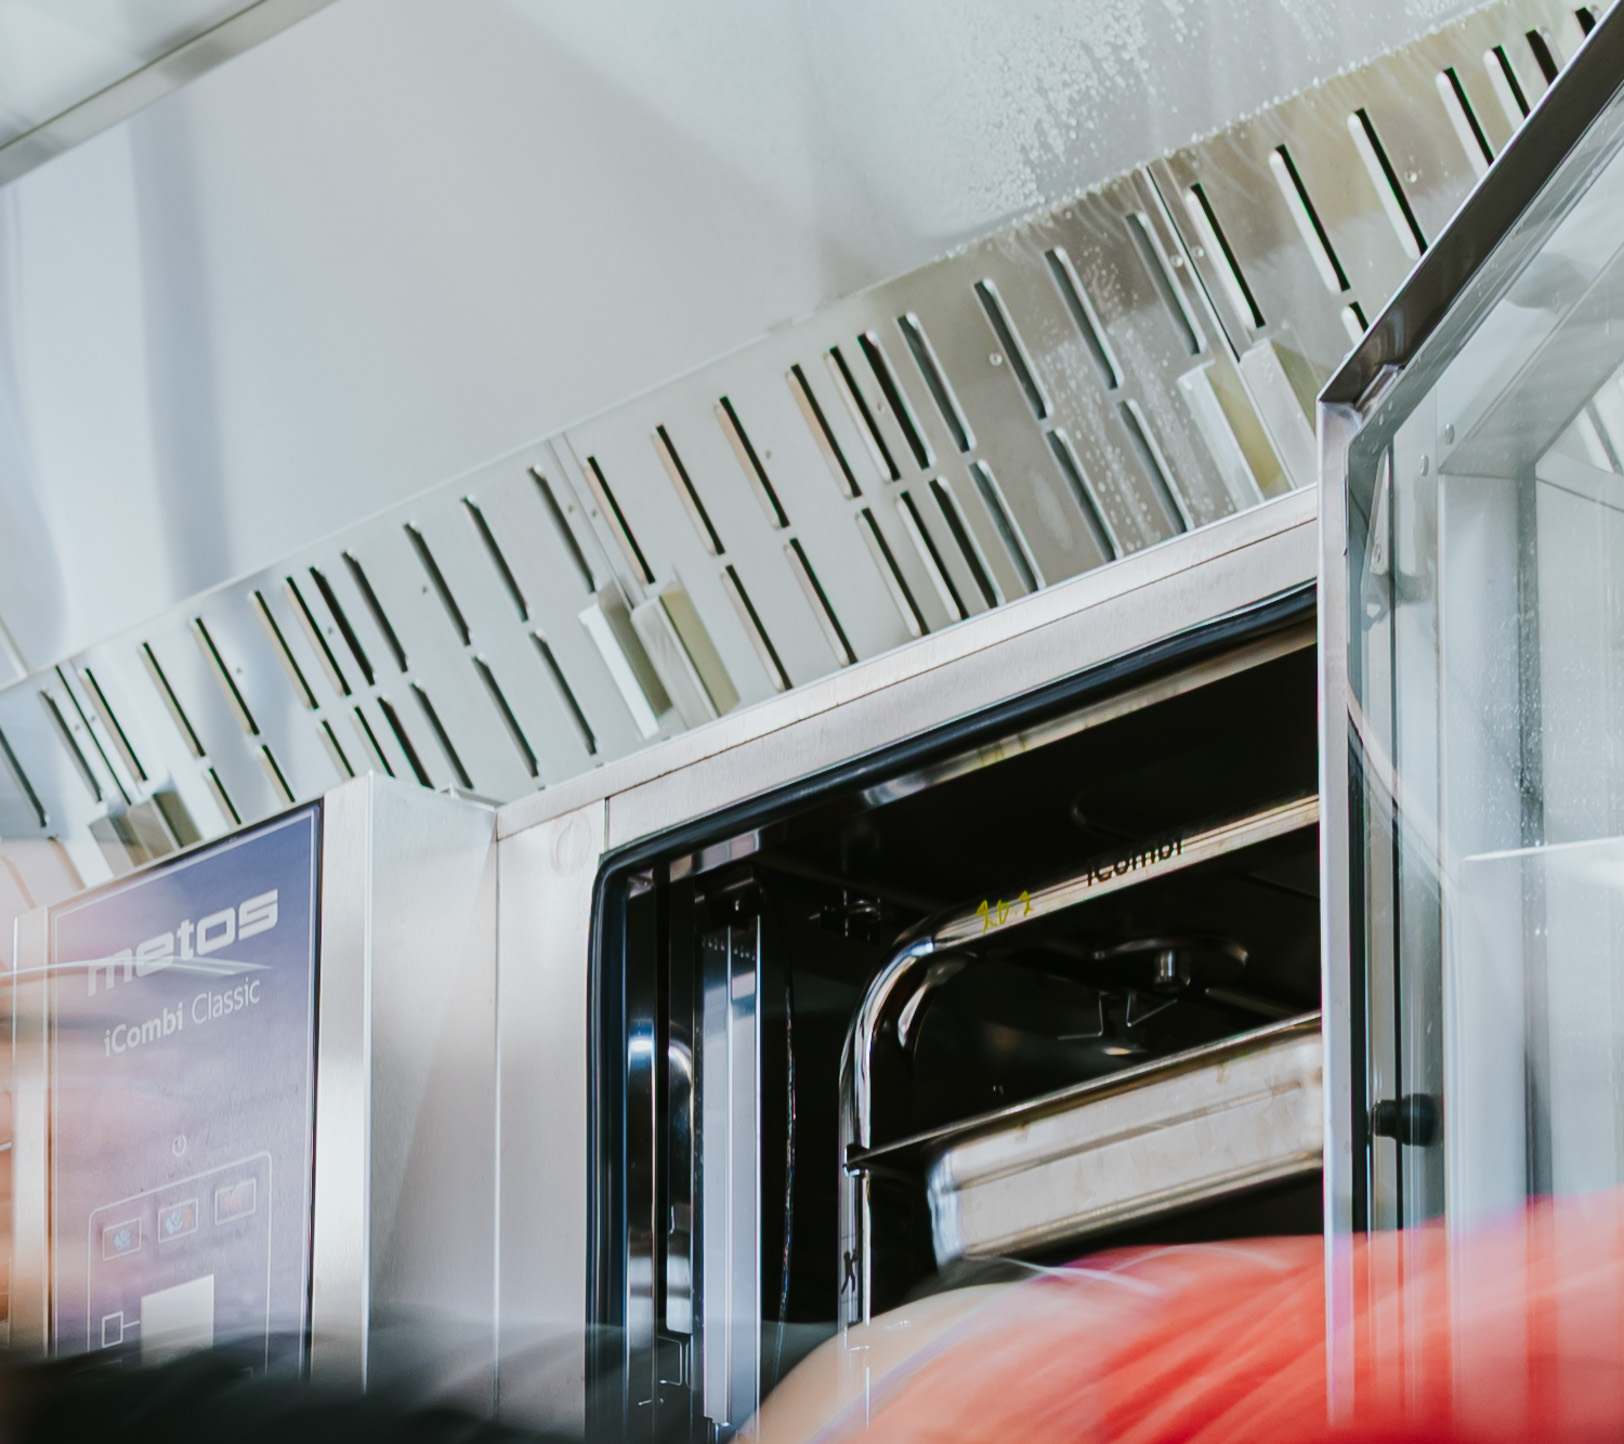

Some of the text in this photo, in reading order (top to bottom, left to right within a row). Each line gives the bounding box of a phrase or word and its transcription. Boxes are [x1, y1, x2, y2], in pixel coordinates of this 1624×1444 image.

[88, 888, 279, 996] metos
[103, 977, 262, 1058] iCombi Classic
